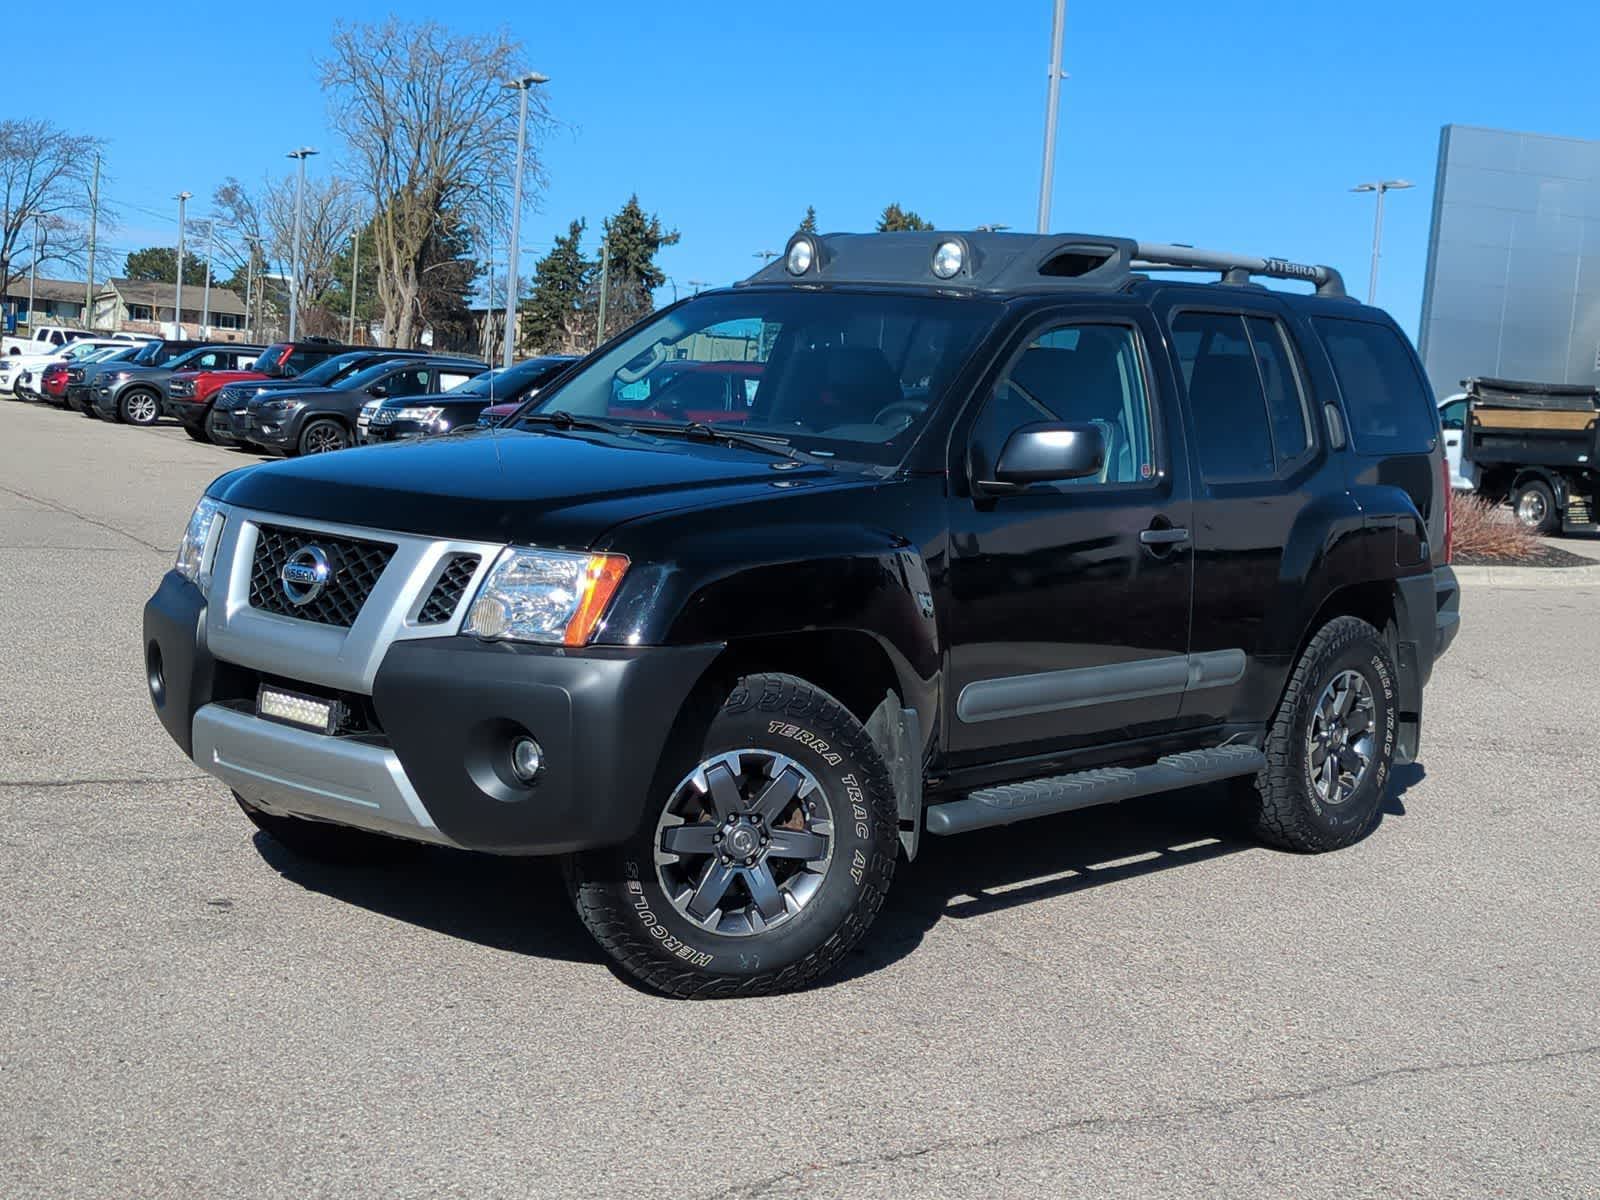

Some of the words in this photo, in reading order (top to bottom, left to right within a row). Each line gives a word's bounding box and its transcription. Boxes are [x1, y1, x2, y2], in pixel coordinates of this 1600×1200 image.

[768, 720, 842, 767] TERRA
[841, 773, 869, 840] TRAC
[849, 849, 871, 886] AT
[625, 861, 714, 967] HERCULES
